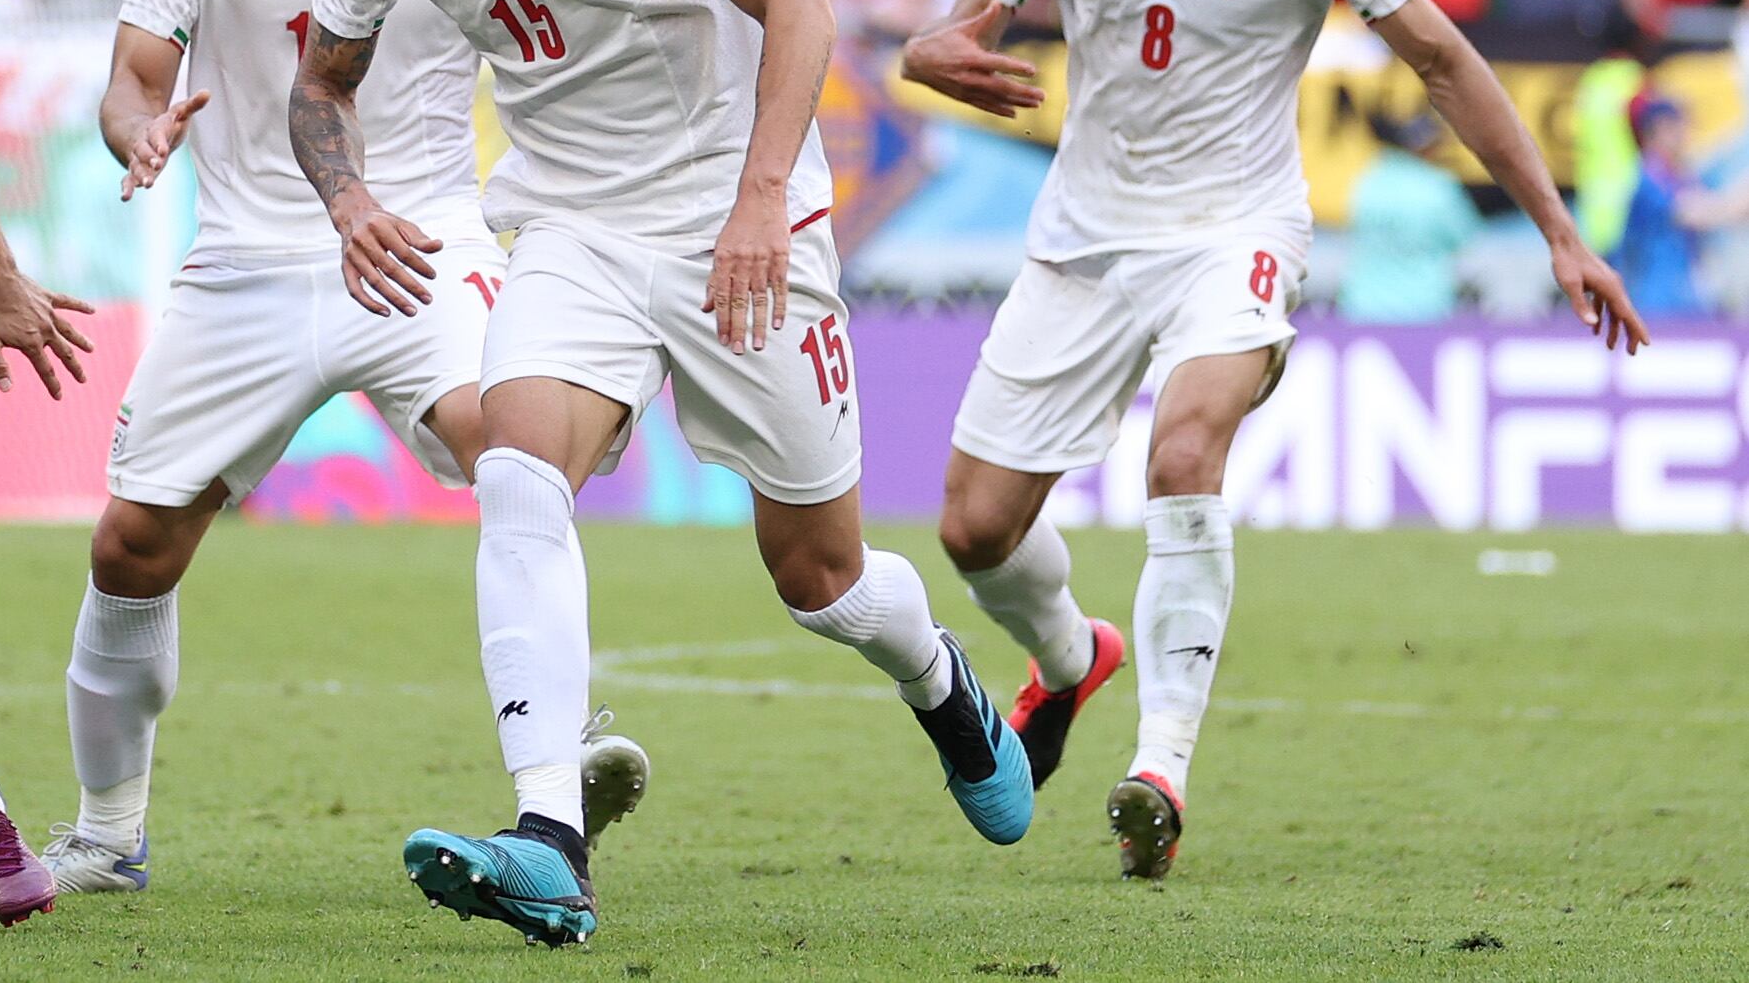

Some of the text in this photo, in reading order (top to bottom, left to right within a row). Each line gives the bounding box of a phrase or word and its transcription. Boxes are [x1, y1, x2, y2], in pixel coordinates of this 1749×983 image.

[1141, 3, 1174, 71] 8
[1250, 250, 1277, 304] 8
[800, 313, 849, 406] 15
